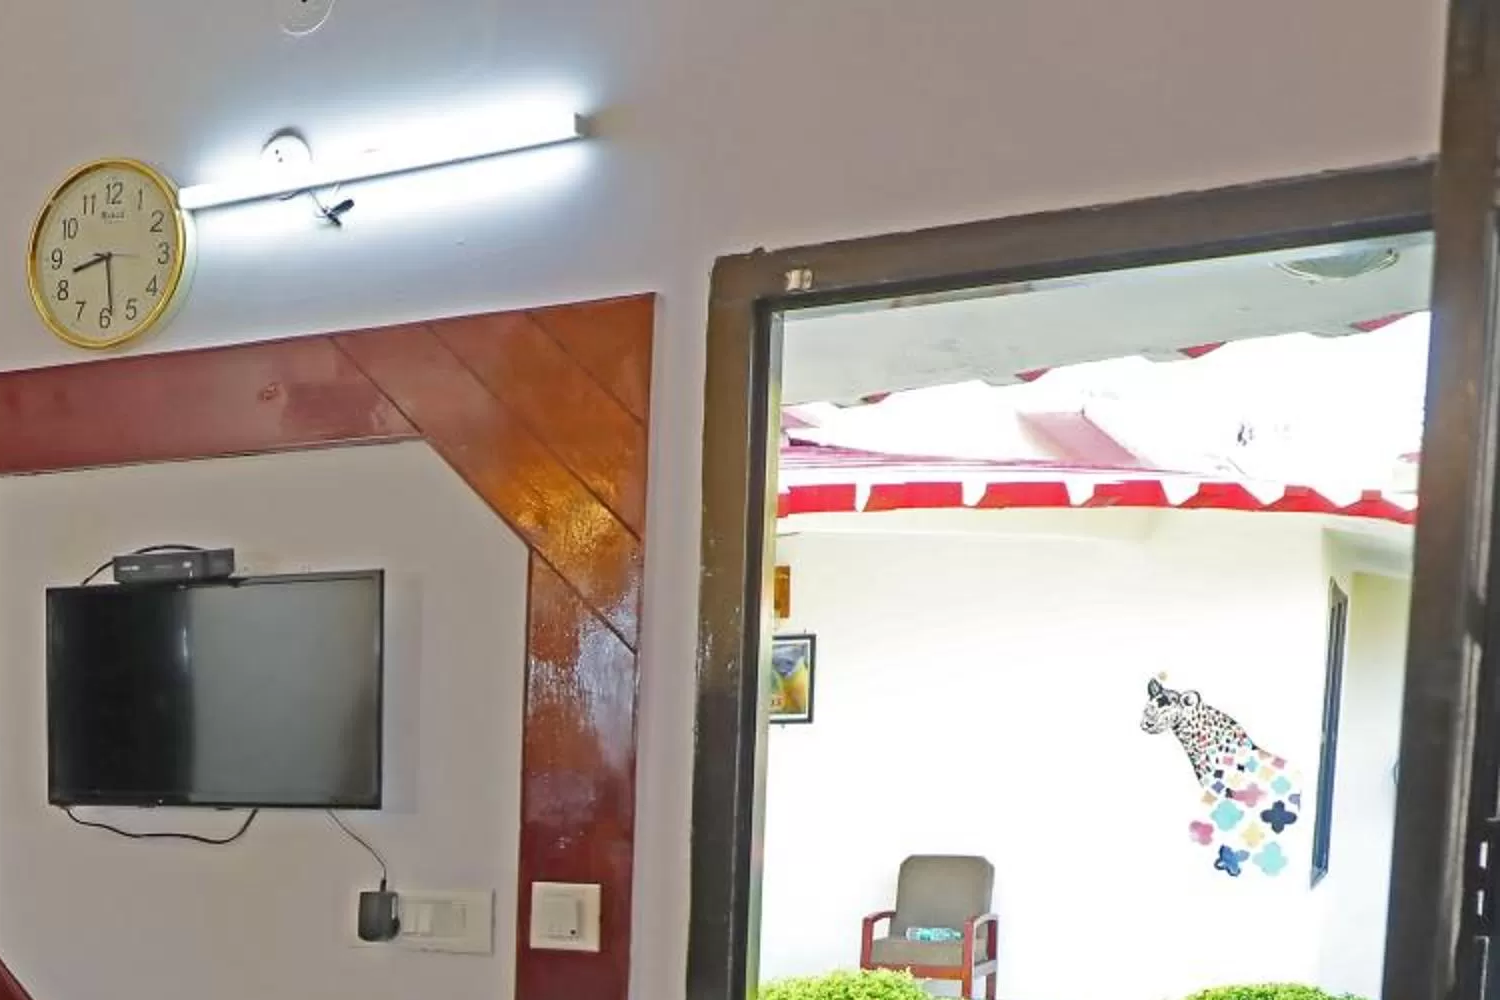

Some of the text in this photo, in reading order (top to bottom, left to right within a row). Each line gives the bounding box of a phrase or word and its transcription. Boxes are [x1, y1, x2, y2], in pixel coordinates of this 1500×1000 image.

[105, 182, 123, 205] 12
[137, 188, 144, 211] 1
[83, 194, 96, 216] 11
[62, 217, 79, 240] 10
[150, 210, 165, 233] 2
[51, 248, 63, 270] 9
[157, 241, 170, 265] 3
[57, 279, 69, 301] 8
[146, 275, 158, 297] 4
[75, 301, 86, 321] 7
[99, 307, 111, 329] 6
[125, 298, 137, 320] 5
